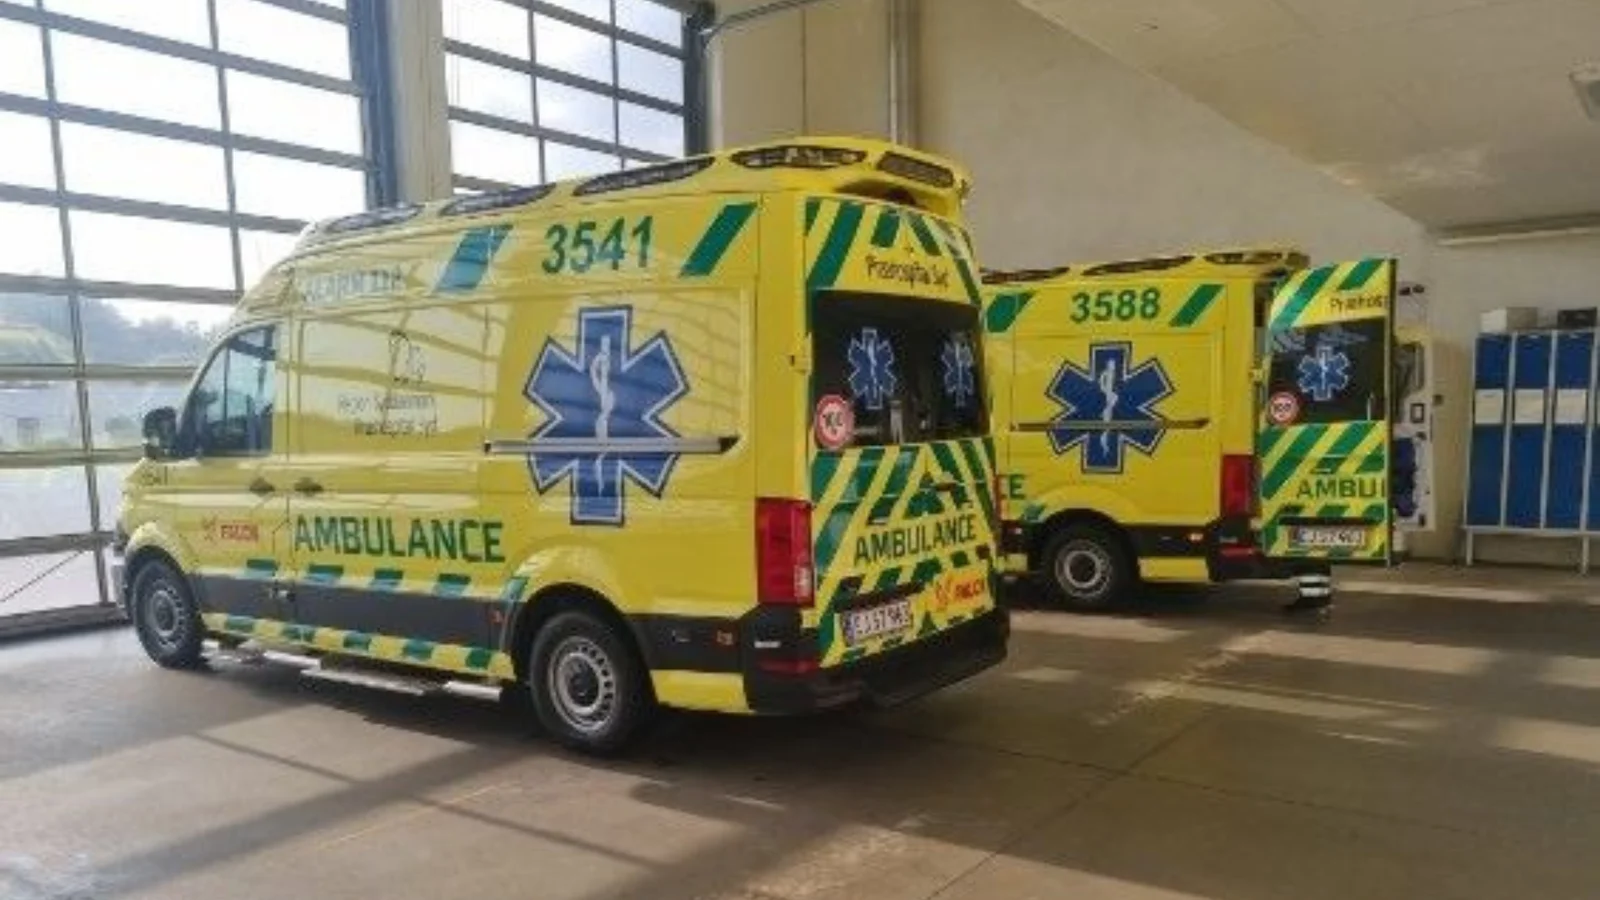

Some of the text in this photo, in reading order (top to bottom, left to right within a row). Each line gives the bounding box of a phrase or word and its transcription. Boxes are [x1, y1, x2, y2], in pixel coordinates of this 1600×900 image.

[541, 215, 653, 273] 3541
[1070, 287, 1161, 324] 3588
[294, 513, 506, 563] AMBULANCE
[854, 514, 977, 567] AMBULANCE
